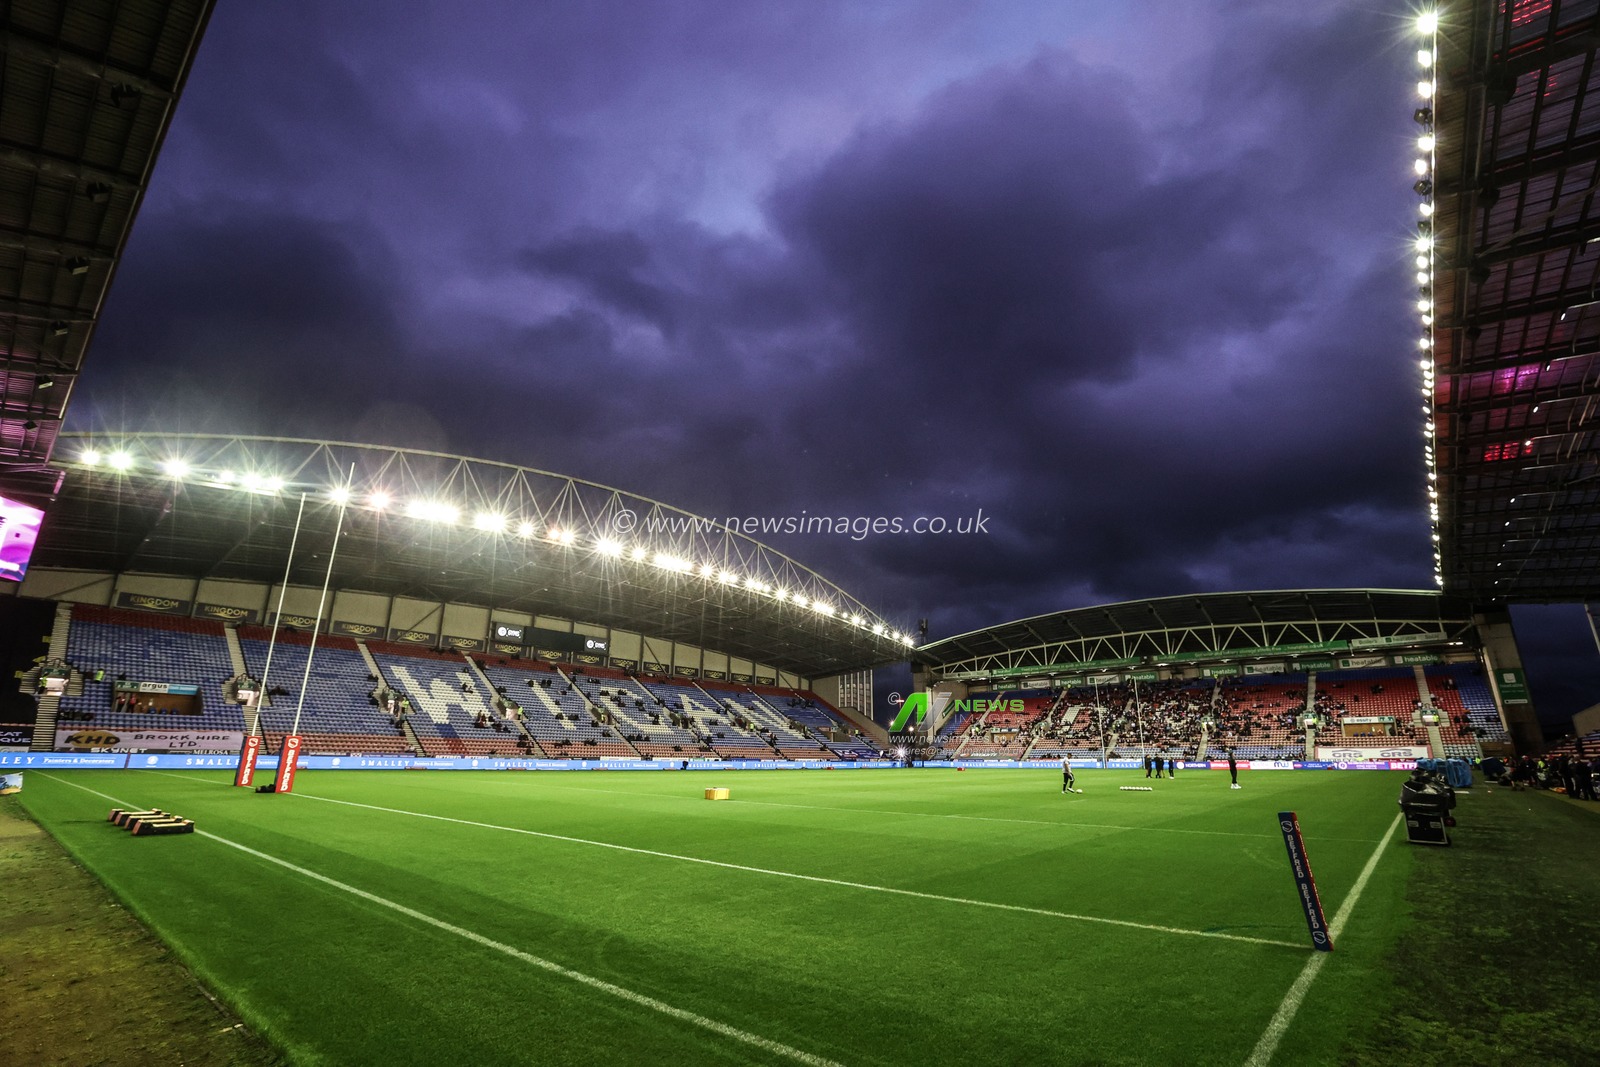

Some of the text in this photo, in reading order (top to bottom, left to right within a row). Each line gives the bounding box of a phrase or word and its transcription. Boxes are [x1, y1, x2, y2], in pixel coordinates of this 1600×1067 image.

[130, 595, 178, 608] KINGDOM
[204, 605, 248, 617] KINGDOM
[342, 624, 377, 634] KINGDOM
[448, 638, 478, 646] KINGDOM
[494, 644, 522, 652] KINGDOM
[1351, 658, 1382, 666] heatable
[1404, 654, 1438, 662] heatable
[64, 736, 120, 744] KHD
[241, 748, 255, 784] BETFRED
[280, 750, 295, 791] BETFRED
[1288, 834, 1304, 878] BETFRED
[1301, 883, 1320, 929] BETFRED
